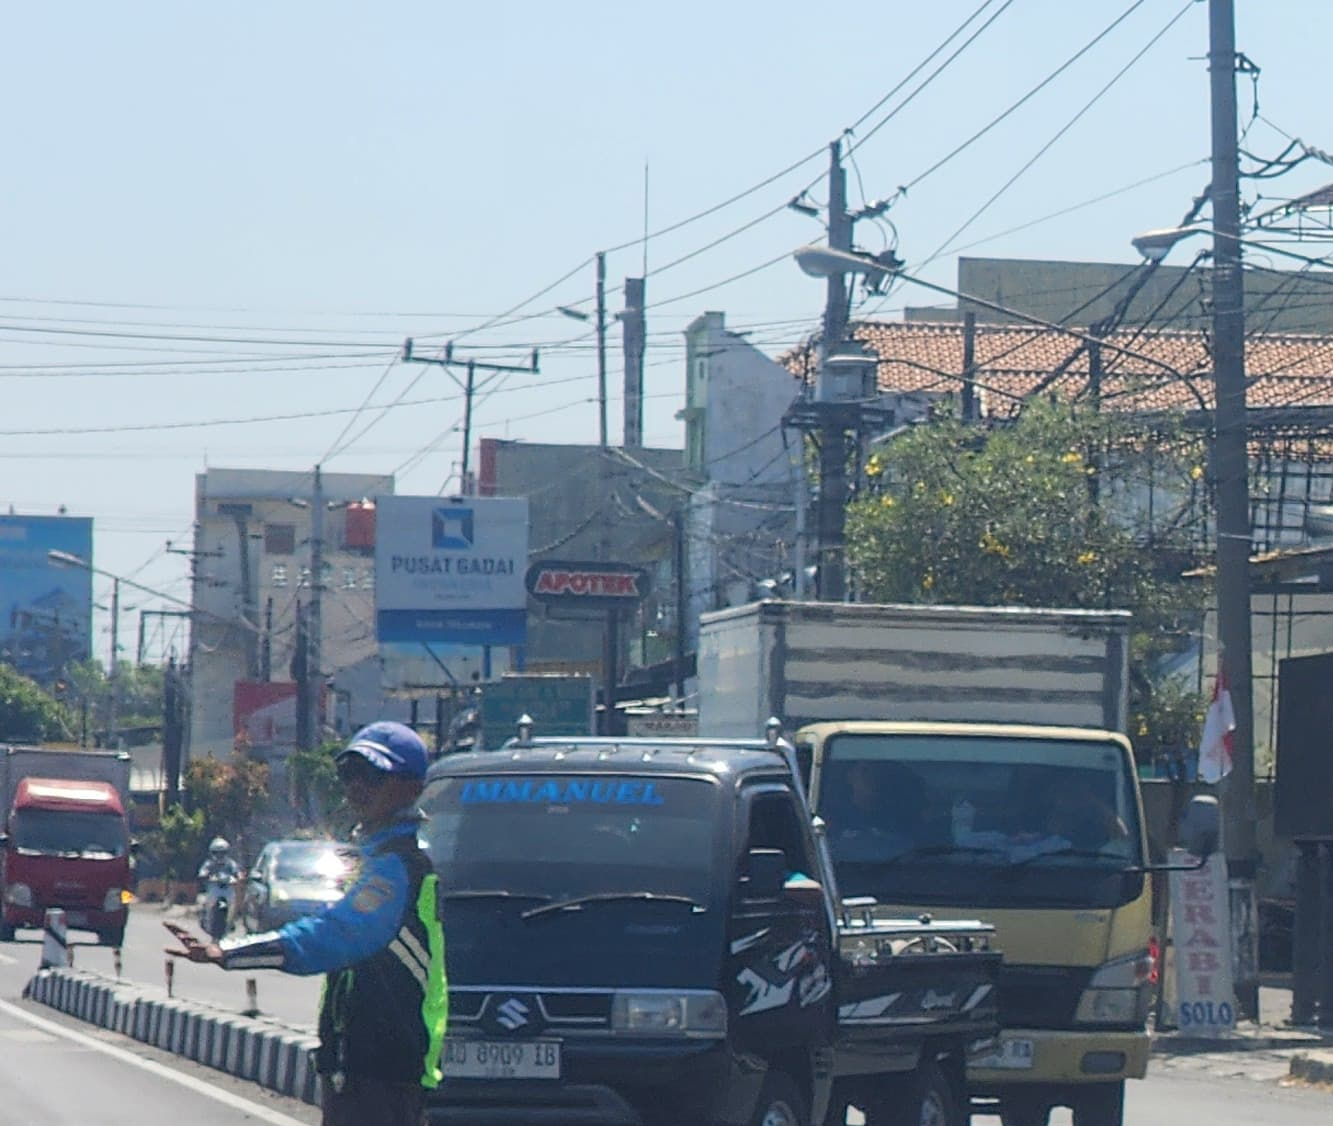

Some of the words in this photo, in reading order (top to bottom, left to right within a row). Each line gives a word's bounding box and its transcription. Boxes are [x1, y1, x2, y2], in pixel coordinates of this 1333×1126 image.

[391, 556, 453, 575] PUSAT
[457, 557, 514, 575] GADAI
[535, 570, 640, 596] APOTEK
[459, 781, 664, 805] IMMANUEL
[1180, 1002, 1233, 1026] SOLO
